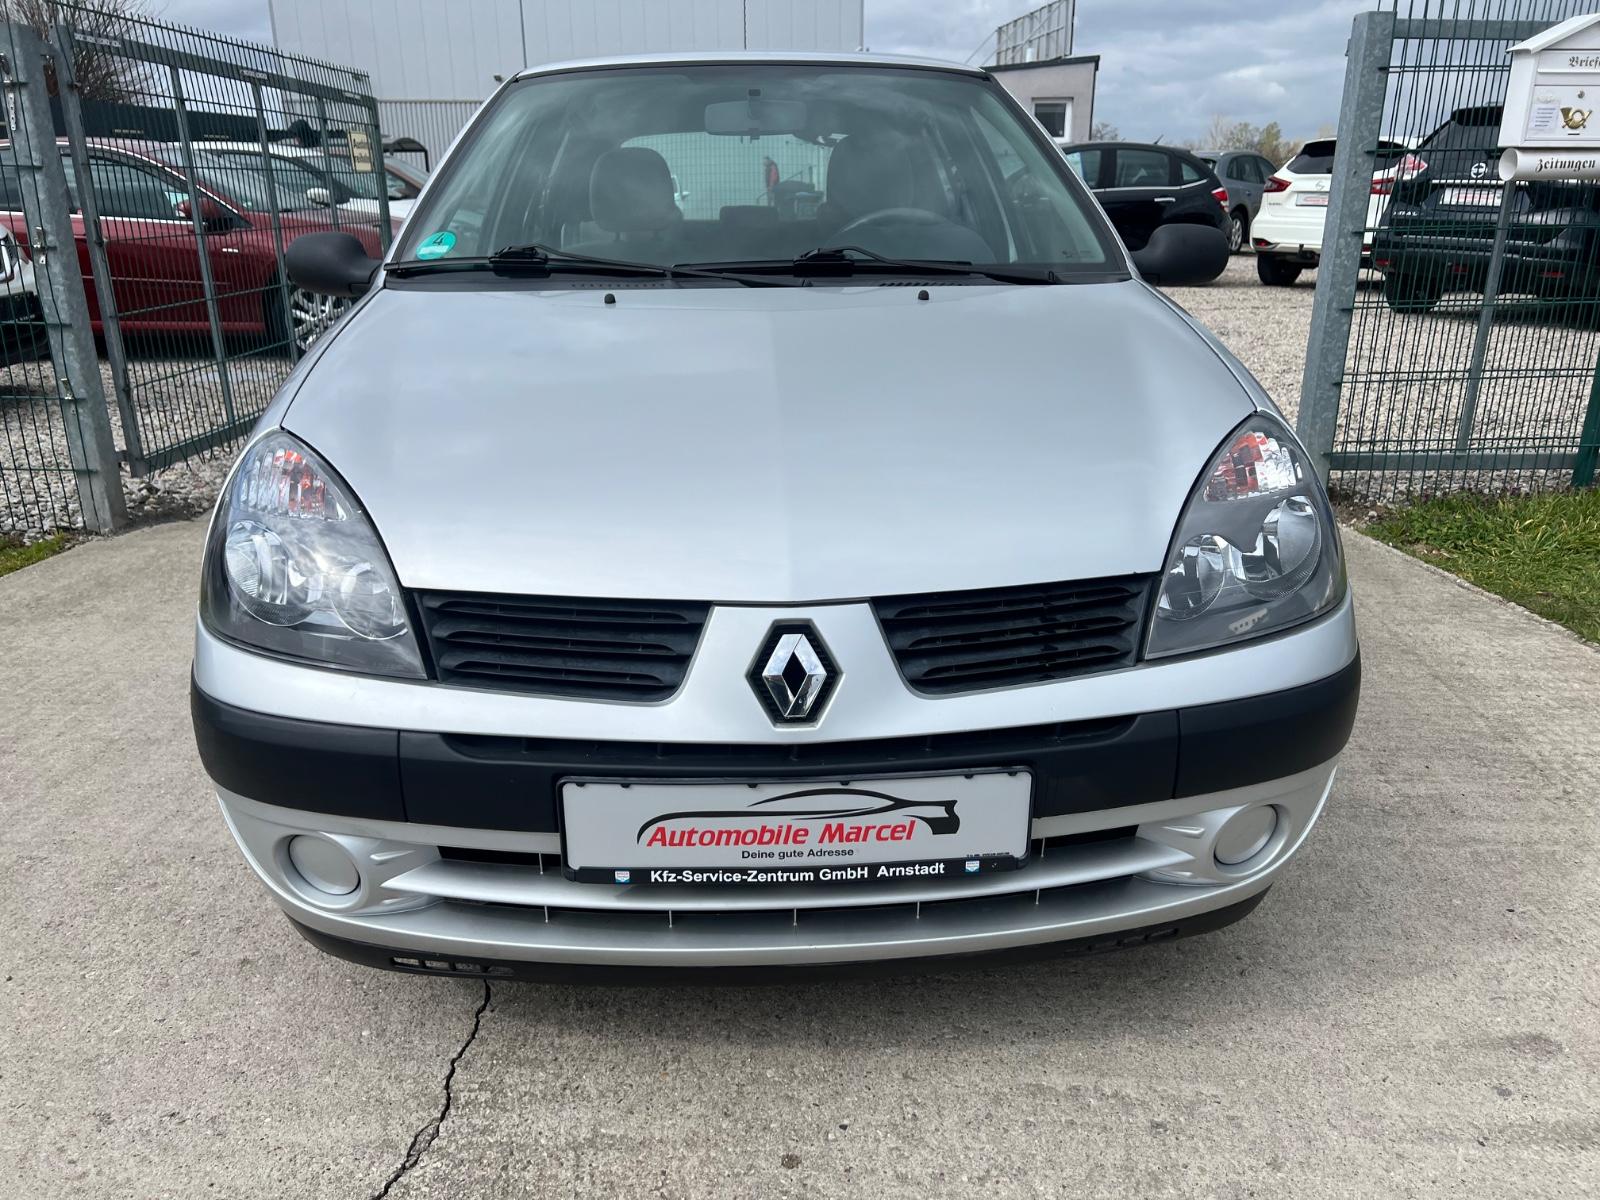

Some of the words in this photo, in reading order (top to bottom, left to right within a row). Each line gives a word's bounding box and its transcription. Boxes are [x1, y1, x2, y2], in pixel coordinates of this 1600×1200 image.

[1569, 55, 1600, 69] Brief
[1535, 157, 1596, 172] Zeitungen
[432, 232, 446, 246] 4
[646, 824, 809, 847] Automobile
[818, 820, 916, 844] Marcel
[741, 850, 775, 859] Deine
[778, 850, 804, 860] gute
[807, 848, 854, 858] Adresse
[650, 870, 814, 883] Kfz-Service-Zentrum
[819, 866, 869, 881] GmbH
[877, 862, 945, 878] Arnstadt
